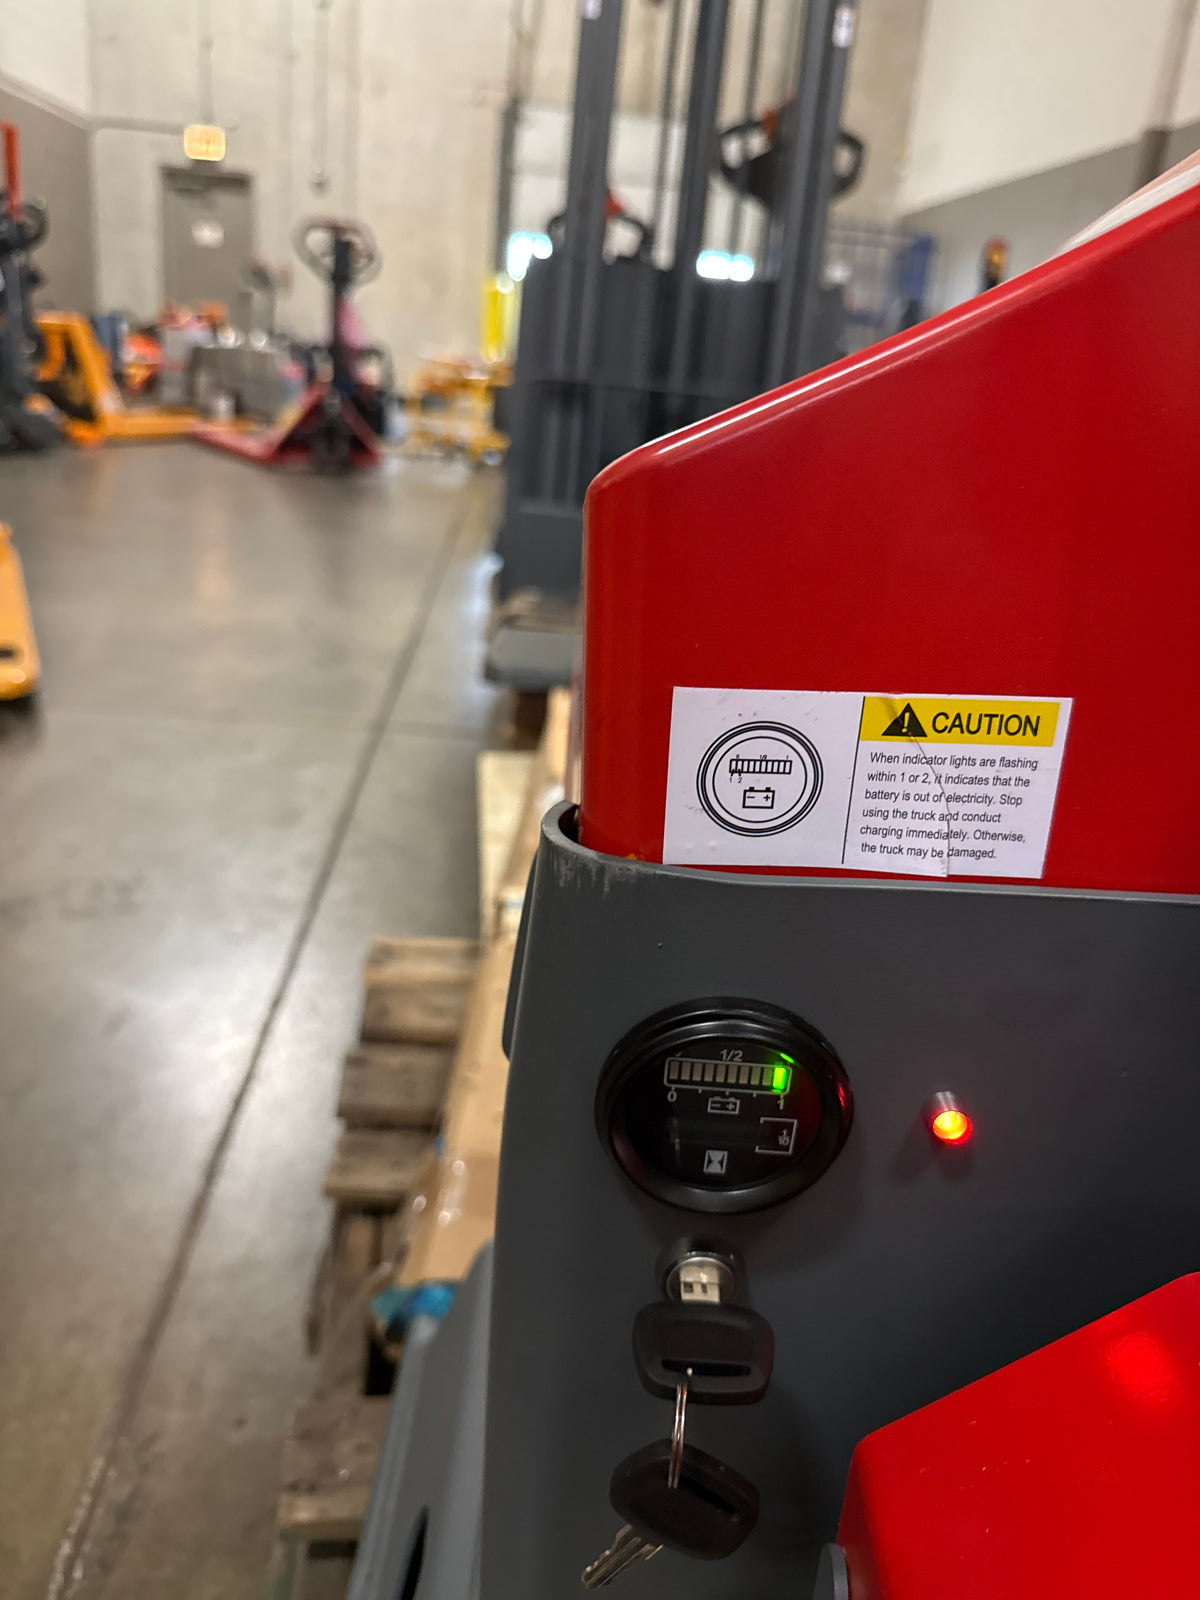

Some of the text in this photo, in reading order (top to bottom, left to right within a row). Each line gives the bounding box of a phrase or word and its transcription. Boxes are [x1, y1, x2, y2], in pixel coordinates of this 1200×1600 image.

[932, 712, 1040, 736] CAUTION
[870, 752, 1038, 770] When indicator lights are flashing
[867, 772, 1030, 787] within 1 or 2, it indicates that the
[865, 790, 1022, 807] battery is out of electricity. Stop
[863, 808, 1001, 823] using the truck and conduct
[860, 826, 1026, 843] charging immediately. Otherwise,
[861, 843, 997, 859] the truck may be damaged.
[720, 1049, 743, 1062] 1/2
[667, 1091, 784, 1110] 0 1
